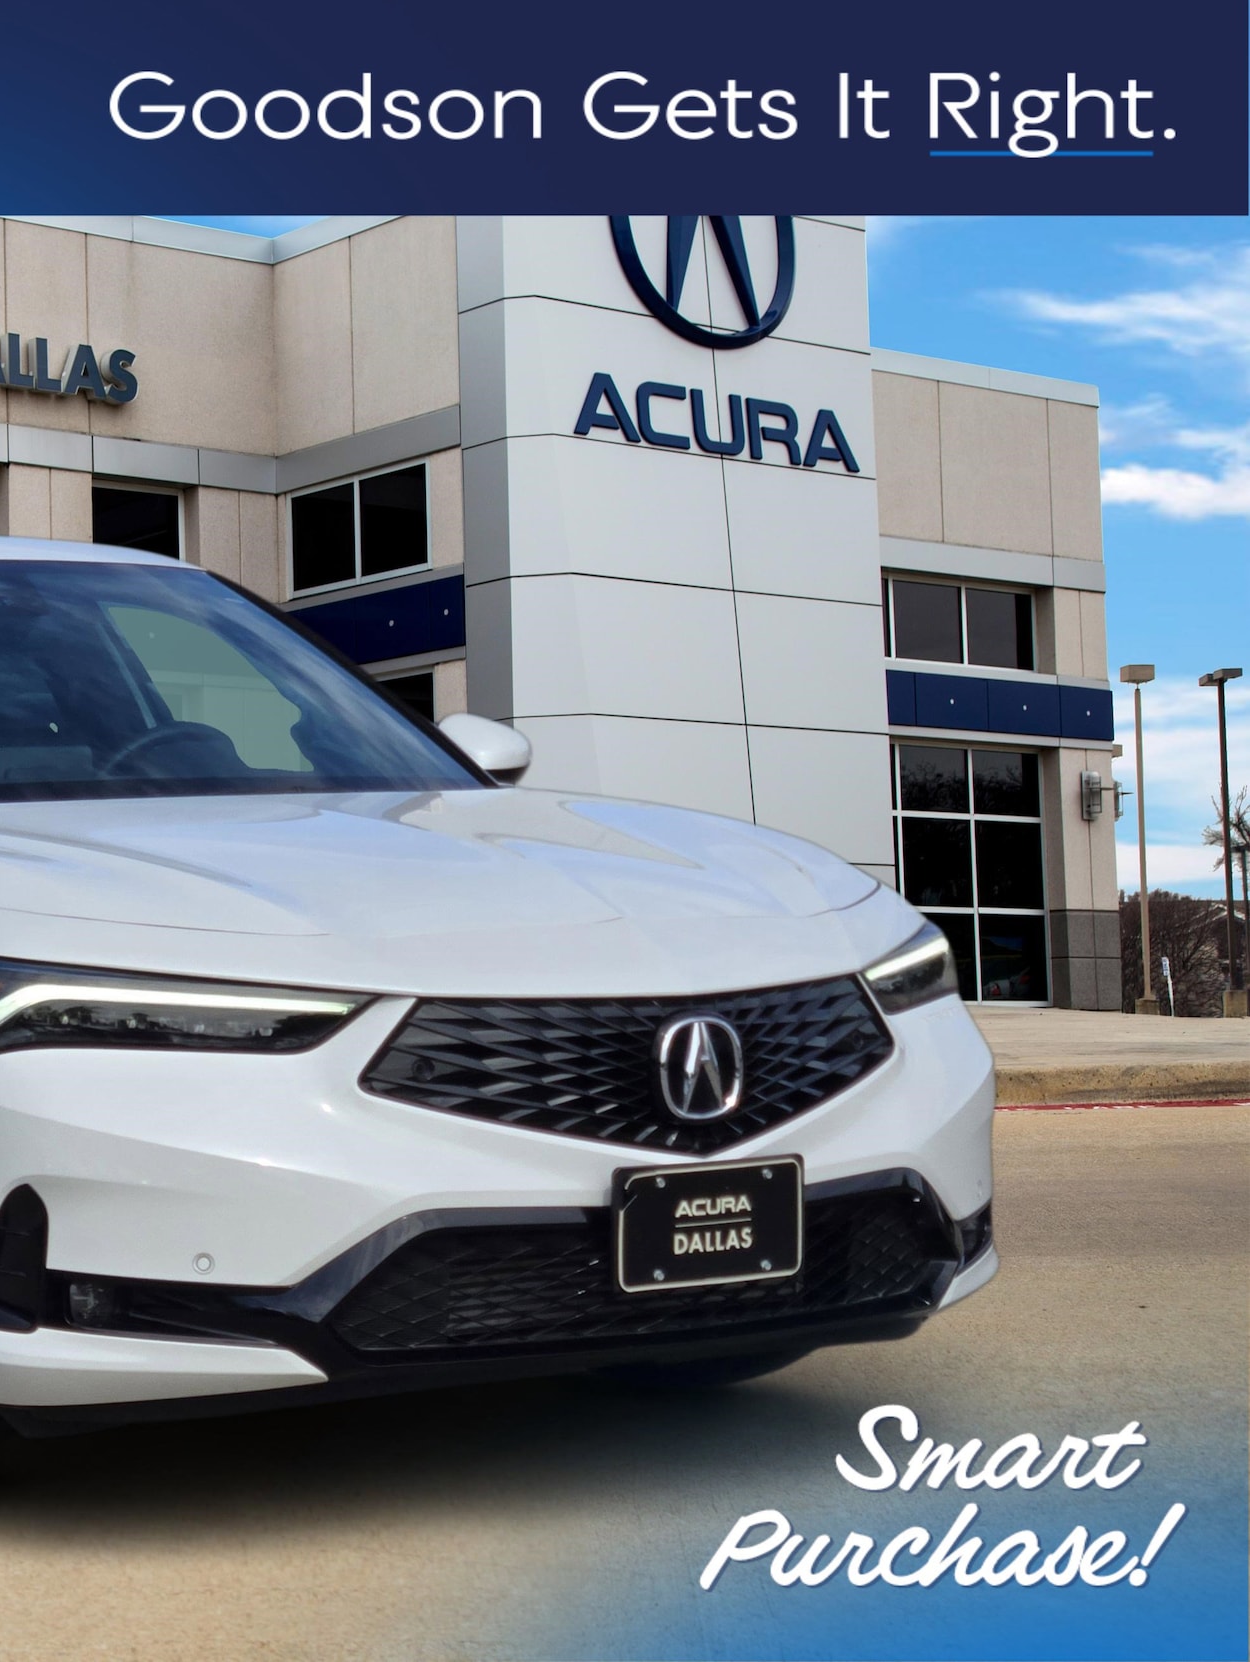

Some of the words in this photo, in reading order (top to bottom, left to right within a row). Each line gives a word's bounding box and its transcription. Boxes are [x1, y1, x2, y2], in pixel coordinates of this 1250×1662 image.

[573, 372, 860, 473] ACURA
[674, 1195, 752, 1218] ACURA
[673, 1227, 753, 1255] DALLAS
